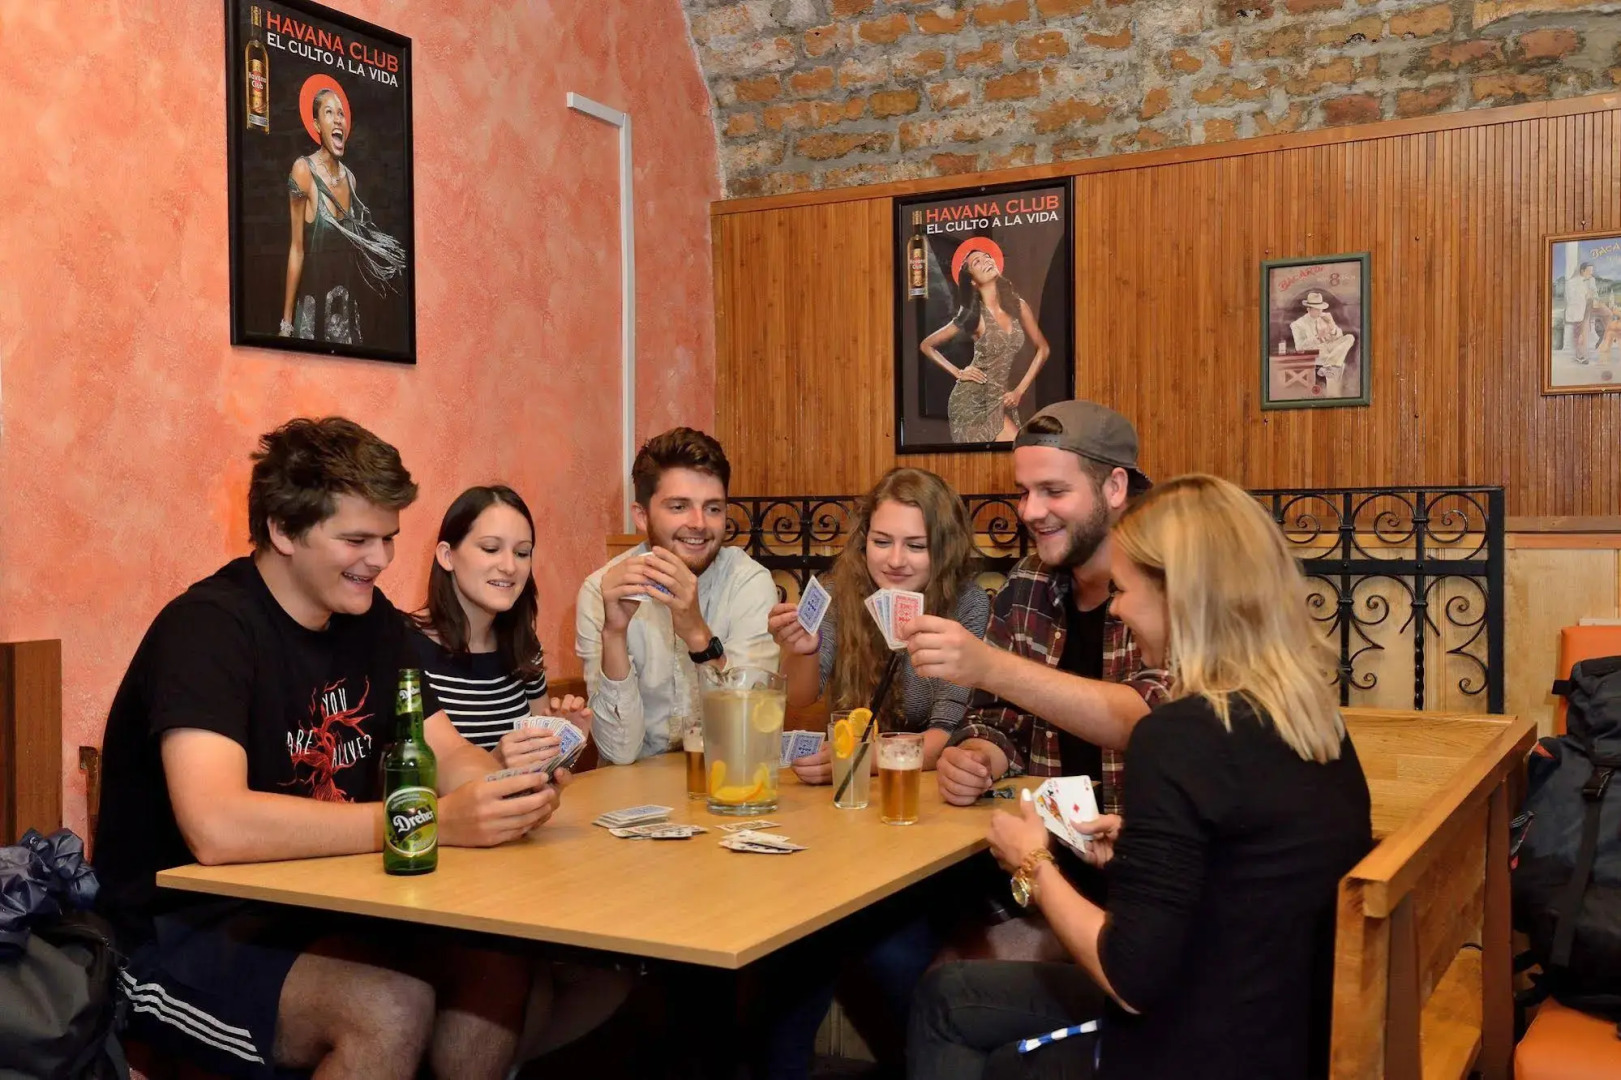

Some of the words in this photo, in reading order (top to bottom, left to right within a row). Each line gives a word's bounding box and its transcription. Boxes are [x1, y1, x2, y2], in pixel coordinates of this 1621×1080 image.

[266, 10, 345, 56] HAVANA
[350, 41, 399, 73] CLUB
[267, 32, 285, 50] EL
[288, 40, 334, 65] CULTO
[336, 57, 346, 70] A
[348, 60, 365, 77] LA
[368, 67, 399, 88] VIDA
[926, 202, 1001, 223] HAVANA
[1005, 195, 1060, 214] CLUB
[926, 224, 943, 235] EL
[945, 218, 989, 233] CULTO
[992, 217, 1001, 228] A
[1004, 215, 1023, 226] LA
[1026, 211, 1059, 224] VIDA
[1329, 272, 1340, 287] 8
[322, 687, 347, 717] YOU
[287, 729, 313, 757] ARE
[332, 734, 372, 768] ALIVE?
